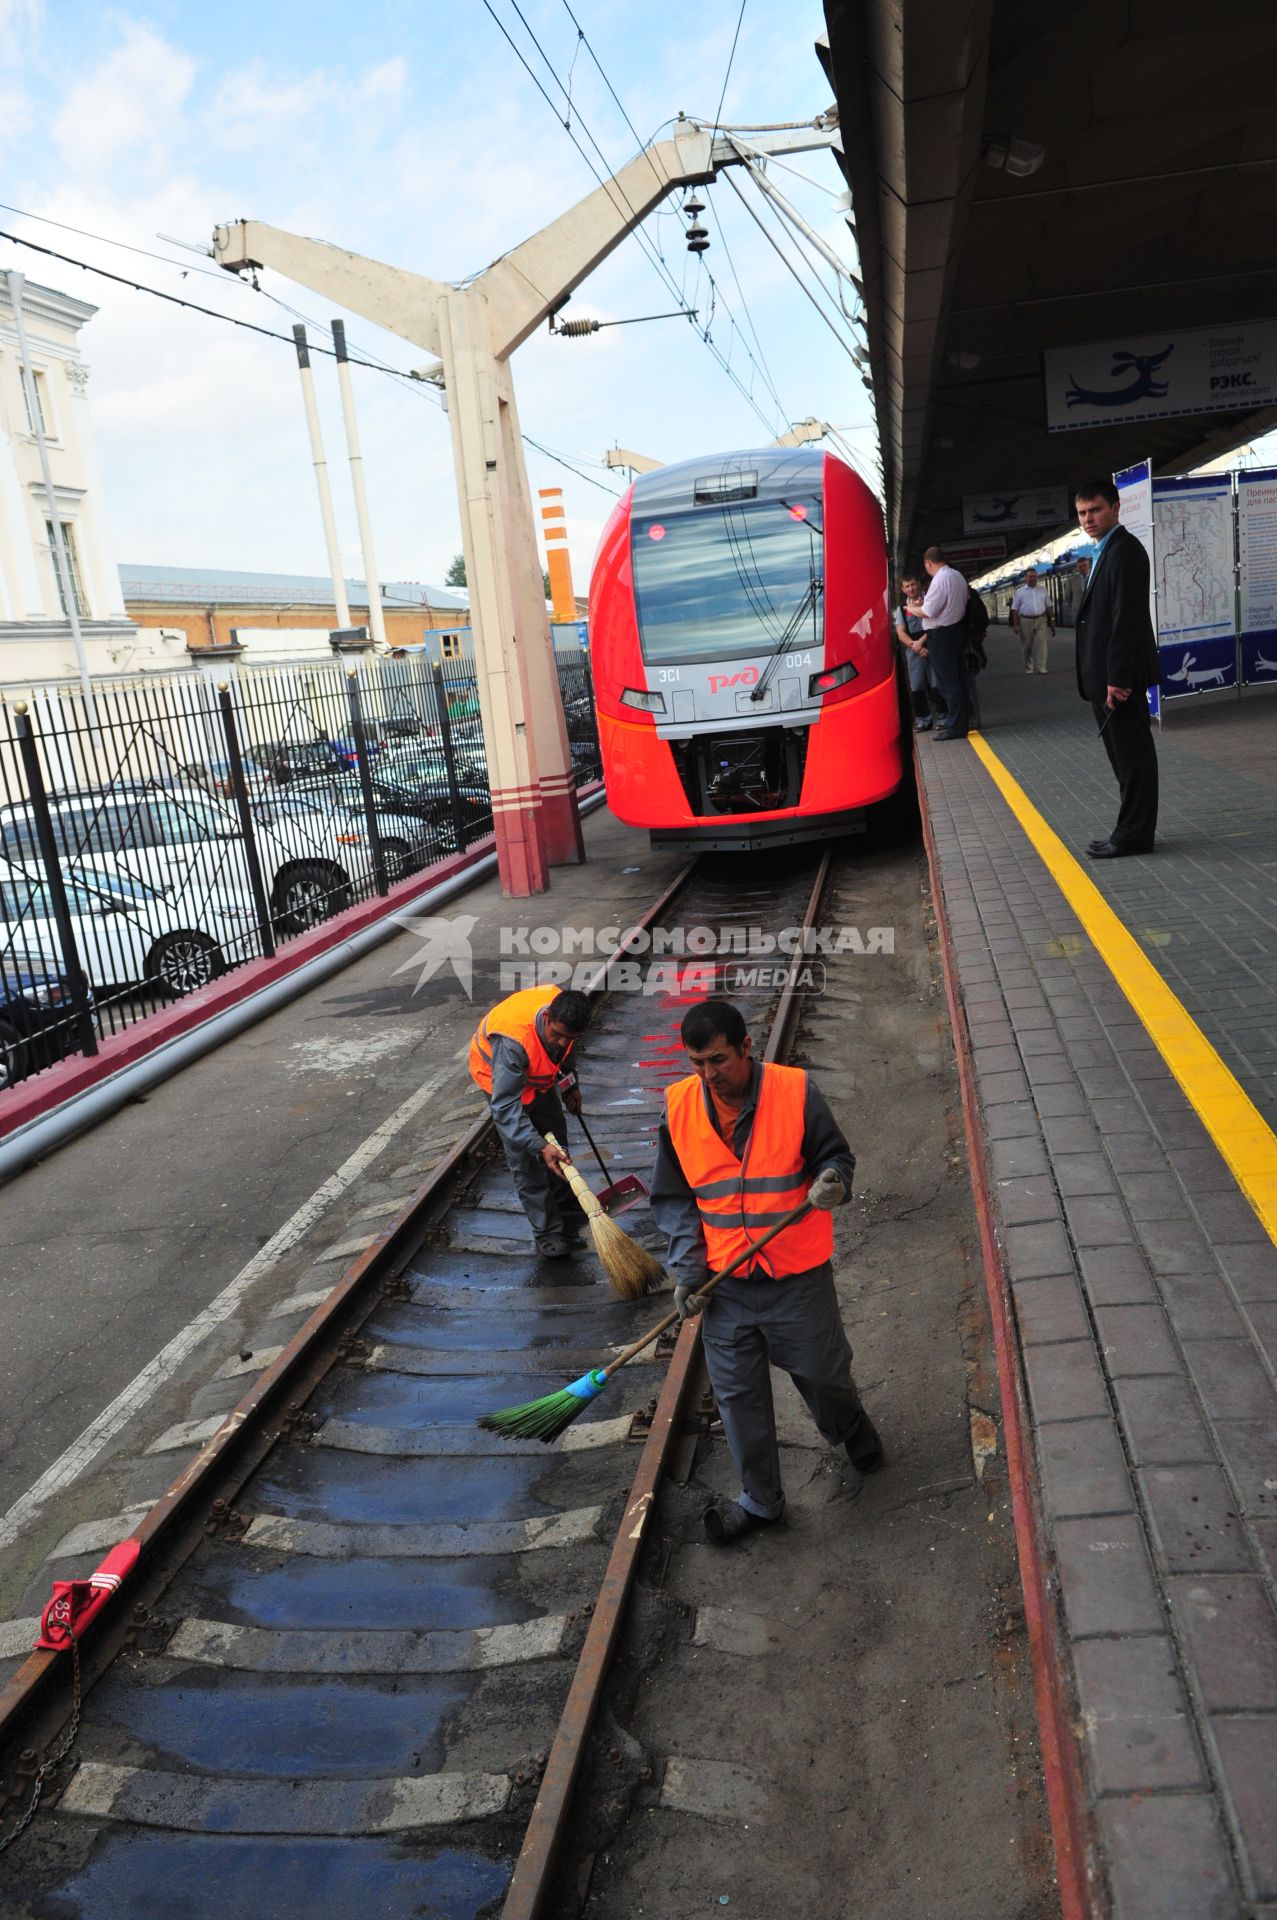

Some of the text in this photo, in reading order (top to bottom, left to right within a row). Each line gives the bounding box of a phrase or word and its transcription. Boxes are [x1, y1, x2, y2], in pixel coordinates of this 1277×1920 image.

[1246, 487, 1277, 499] Преиму
[786, 653, 812, 669] 004
[54, 1600, 71, 1620] 85
